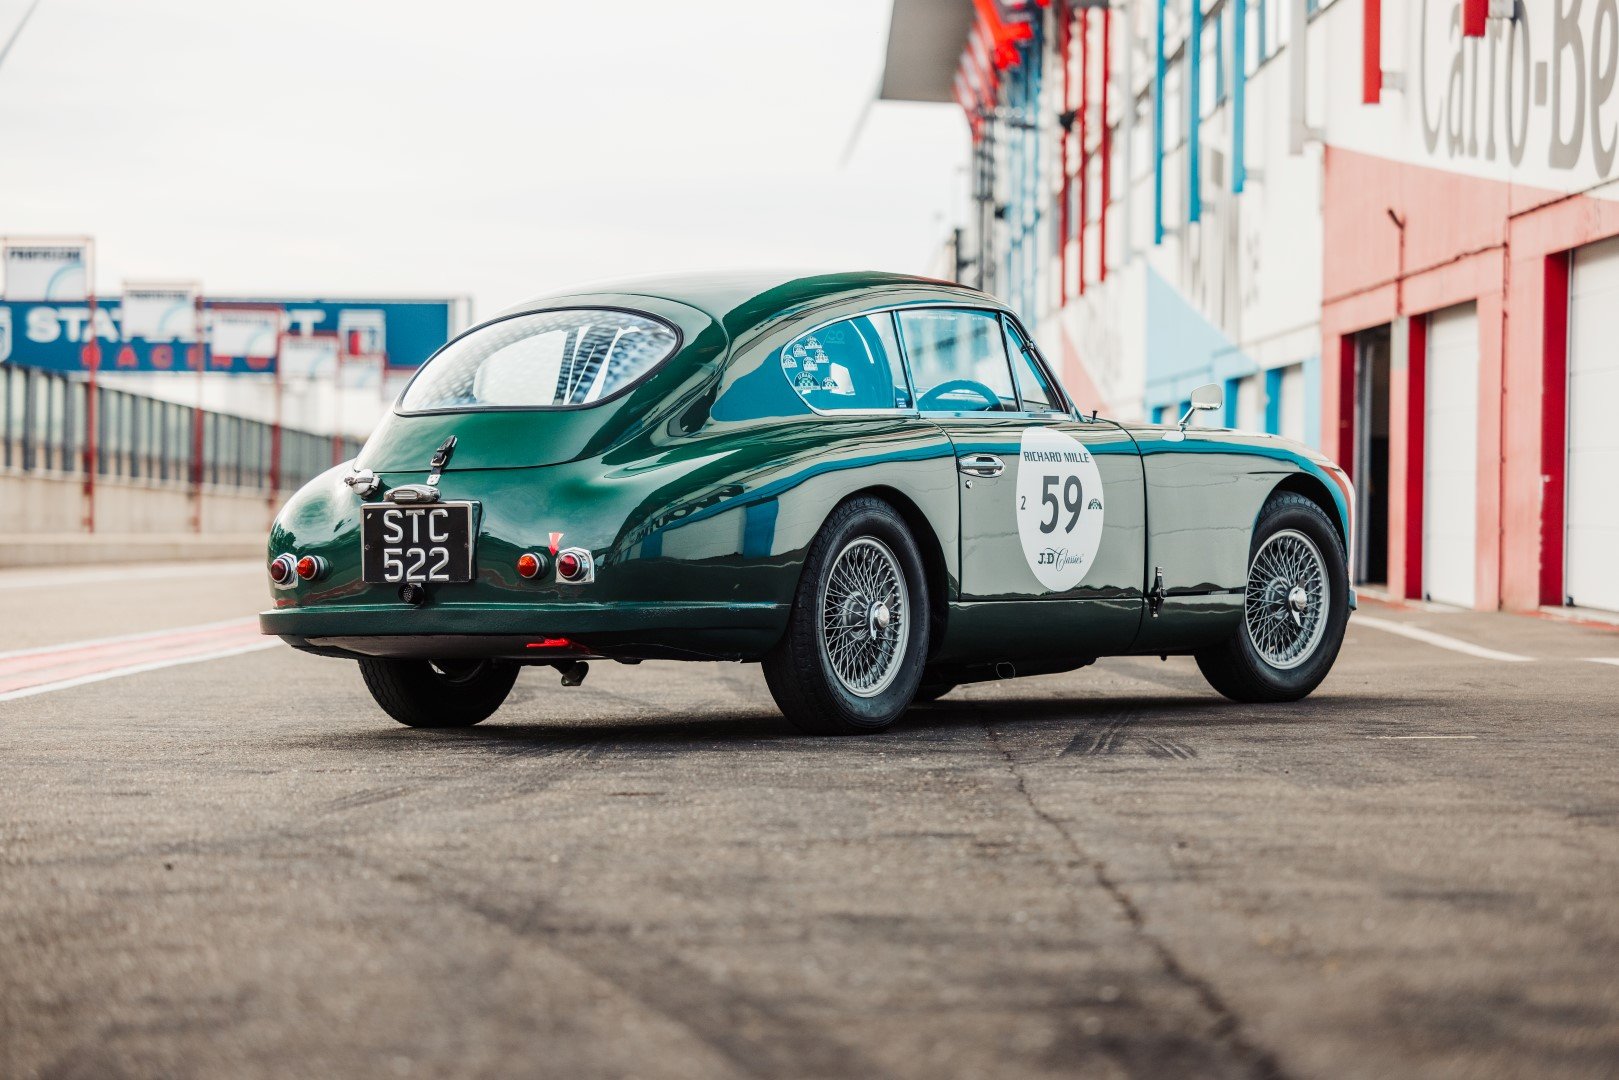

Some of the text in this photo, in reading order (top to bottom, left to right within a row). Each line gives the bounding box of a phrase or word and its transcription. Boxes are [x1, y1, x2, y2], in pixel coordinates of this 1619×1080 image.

[1023, 451, 1090, 463] RICHARD MILLE
[1020, 495, 1027, 510] 2
[1039, 475, 1083, 534] 59
[383, 509, 449, 543] STC
[383, 547, 450, 582] 522
